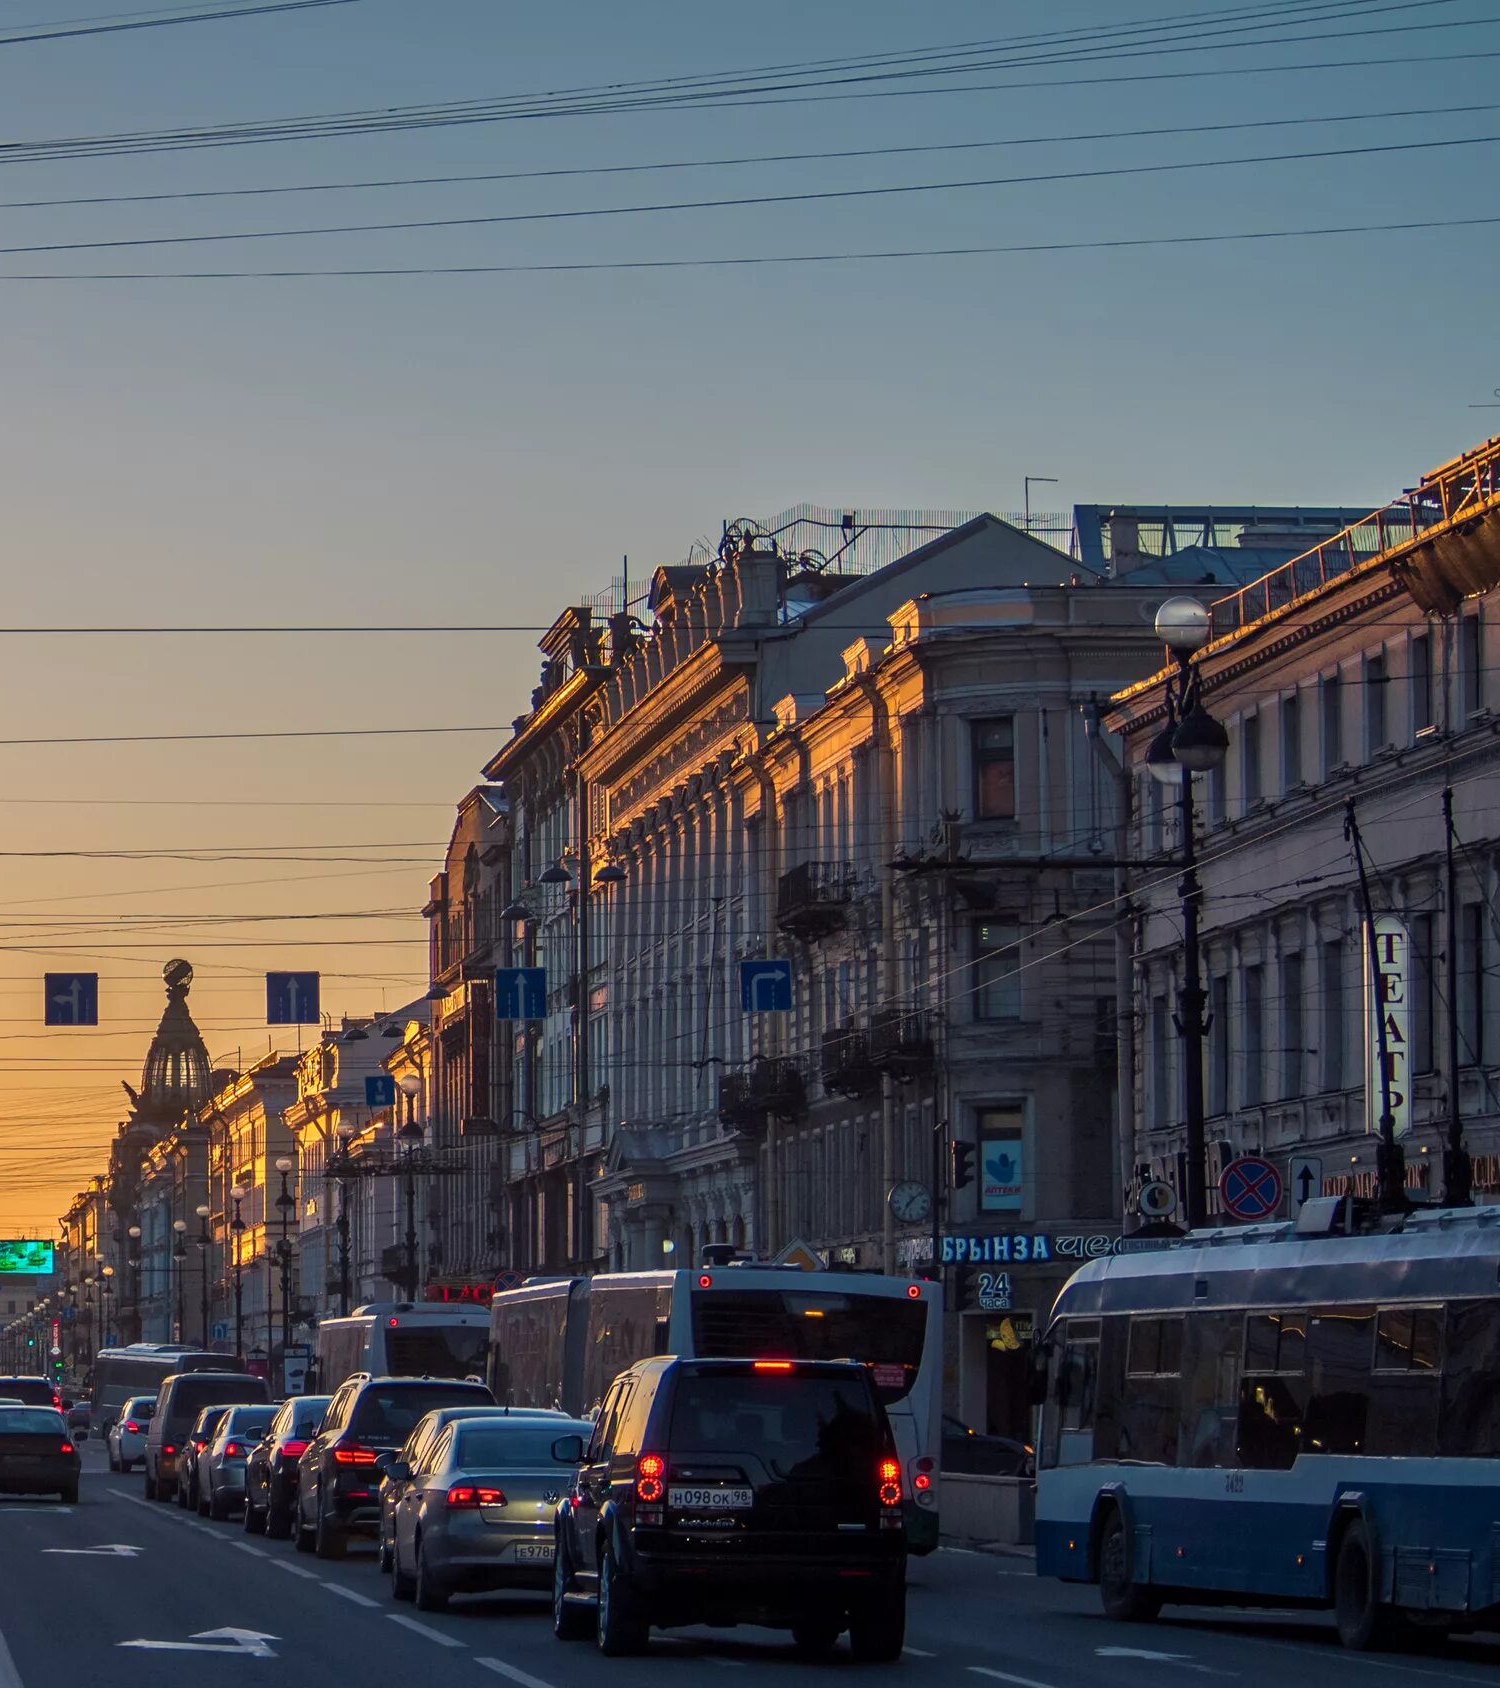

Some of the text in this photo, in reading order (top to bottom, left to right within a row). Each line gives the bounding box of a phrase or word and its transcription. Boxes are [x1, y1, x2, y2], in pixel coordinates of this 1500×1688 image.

[941, 1234, 1051, 1263] БРЫНЗА
[978, 1272, 1009, 1297] 24
[979, 1297, 1009, 1310] часа
[733, 1490, 748, 1502] 98
